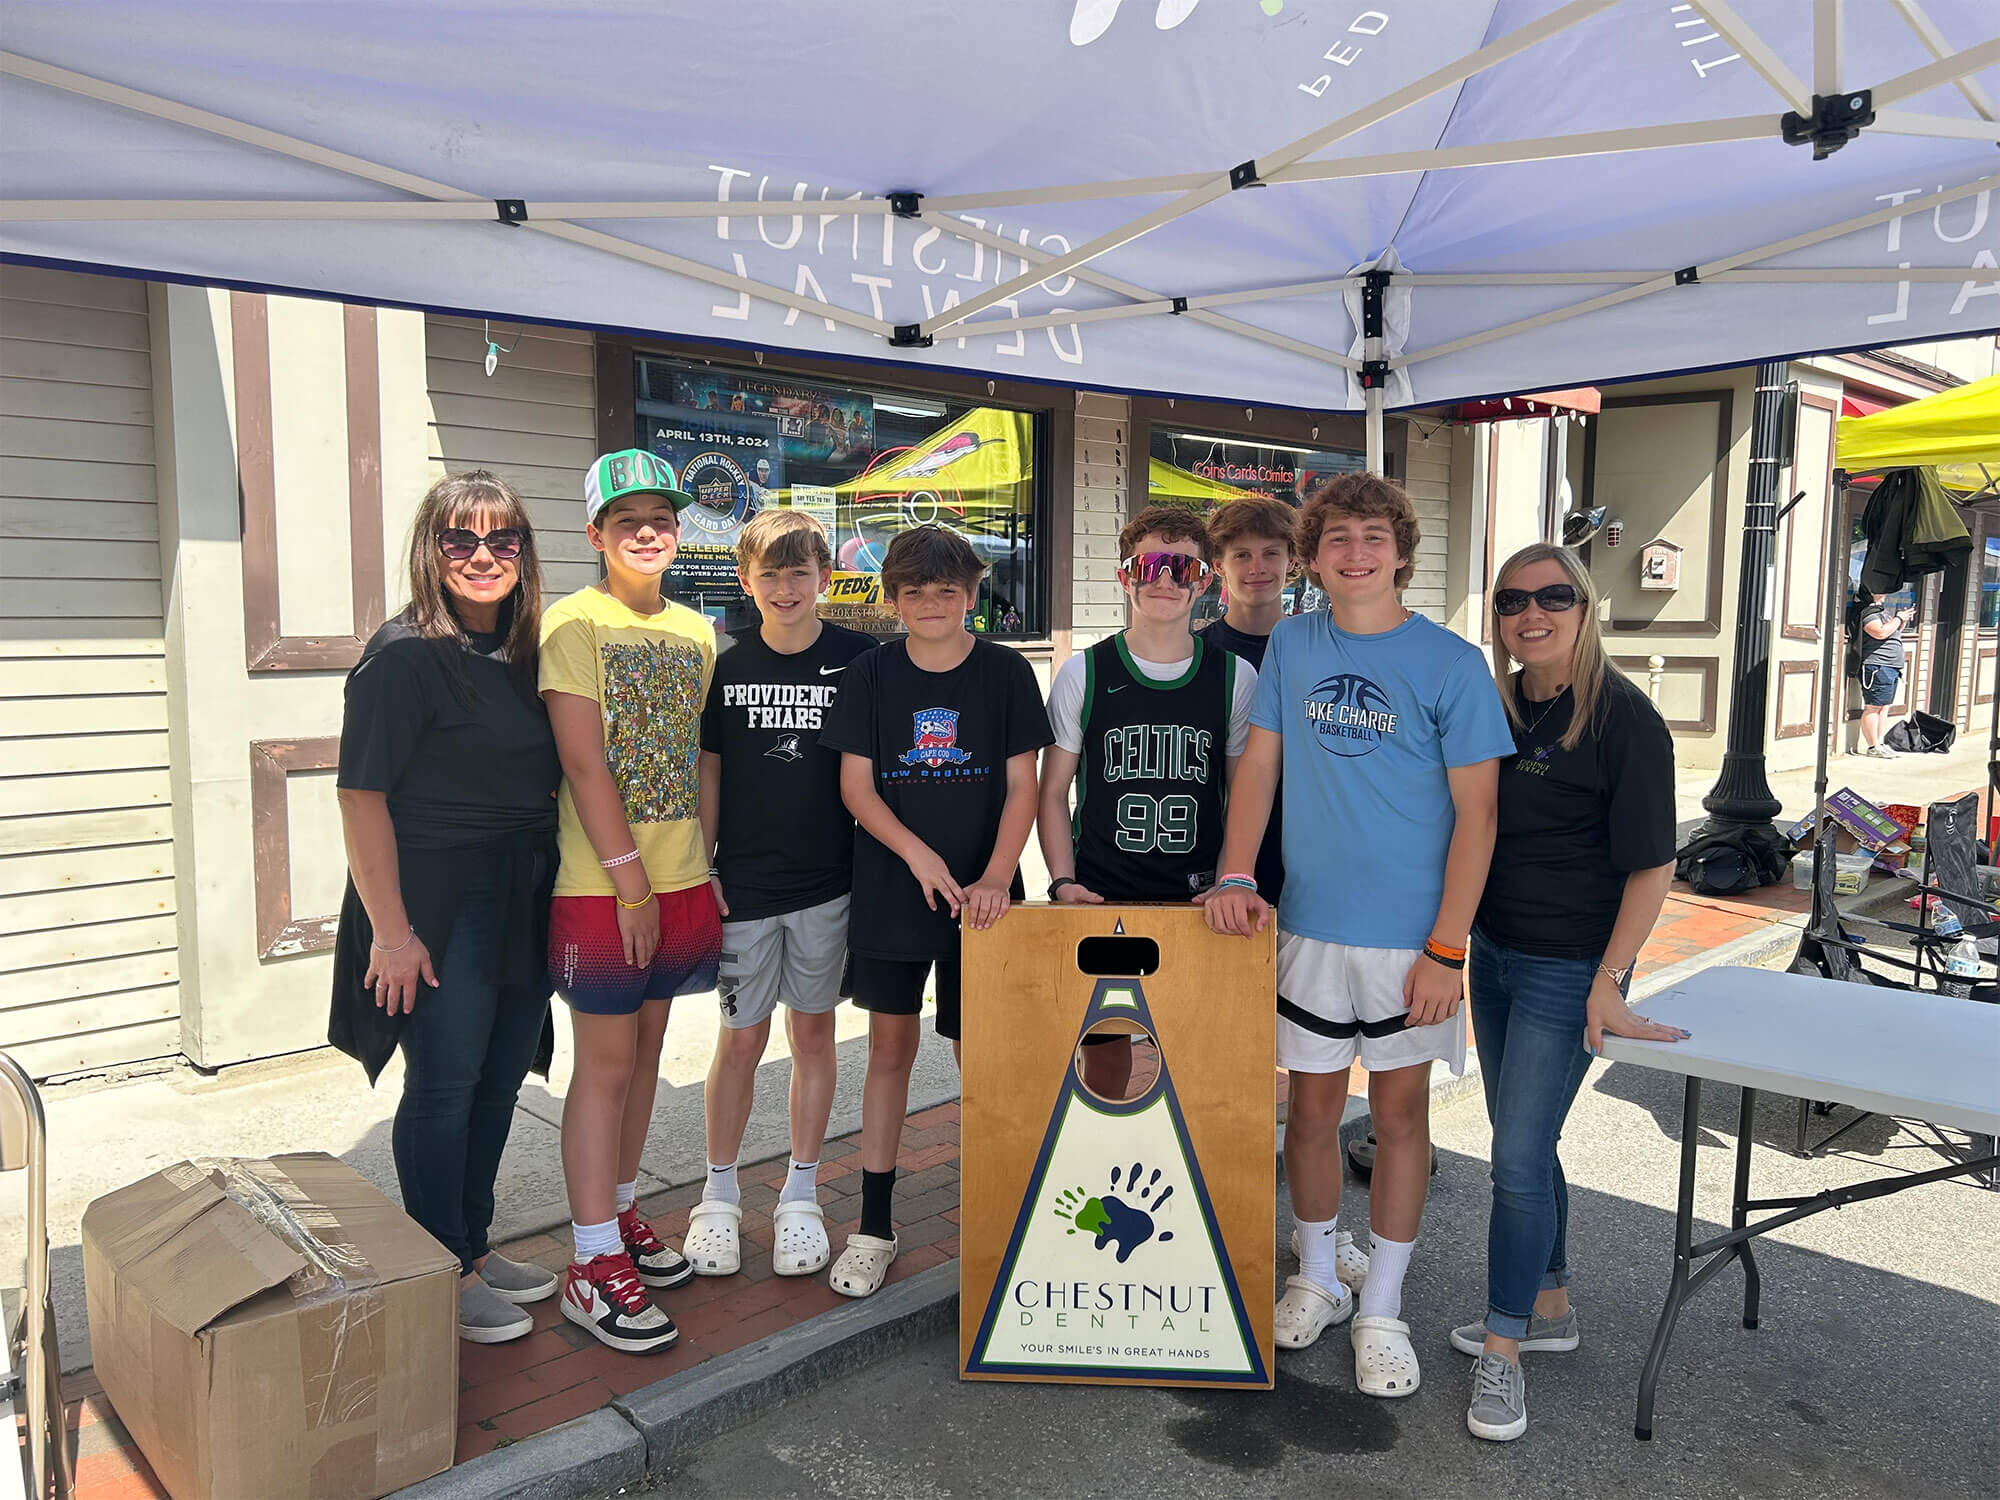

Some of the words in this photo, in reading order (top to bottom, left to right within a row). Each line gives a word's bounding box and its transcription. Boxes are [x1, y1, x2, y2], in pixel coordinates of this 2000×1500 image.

[738, 380, 818, 400] LEGENDARY
[656, 428, 696, 442] APRIL
[699, 432, 734, 446] 13TH,
[737, 436, 770, 448] 2024
[608, 452, 671, 492] BOS
[684, 455, 718, 483] NATIONAL
[719, 456, 746, 487] HOCKEY
[1194, 461, 1226, 479] Coins
[1227, 464, 1257, 481] Cards
[1257, 465, 1294, 483] Comics
[701, 486, 730, 494] UPPER
[694, 512, 718, 530] CARD
[720, 514, 738, 530] DAY
[679, 542, 738, 554] CELEBRA
[693, 553, 714, 561] FREE
[669, 563, 685, 571] OOK
[831, 575, 874, 597] TED'S
[723, 683, 838, 707] PROVIDENC
[747, 707, 823, 730] FRIARS
[1303, 700, 1336, 723] TAKE
[1338, 704, 1399, 735] CHARGE
[1319, 722, 1374, 743] BASKETBALL
[920, 749, 937, 759] CAPE
[937, 749, 950, 758] COD
[1103, 723, 1213, 785] CELTICS
[881, 769, 911, 779] new
[920, 765, 990, 778] england
[1115, 792, 1198, 854] 99
[1015, 1280, 1216, 1314] CHESTNUT
[1020, 1312, 1210, 1332] DENTAL
[1021, 1343, 1053, 1354] YOUR
[1058, 1344, 1103, 1356] SMILE'S
[1107, 1346, 1120, 1355] IN
[1124, 1347, 1164, 1358] GREAT
[1168, 1349, 1210, 1359] HANDS
